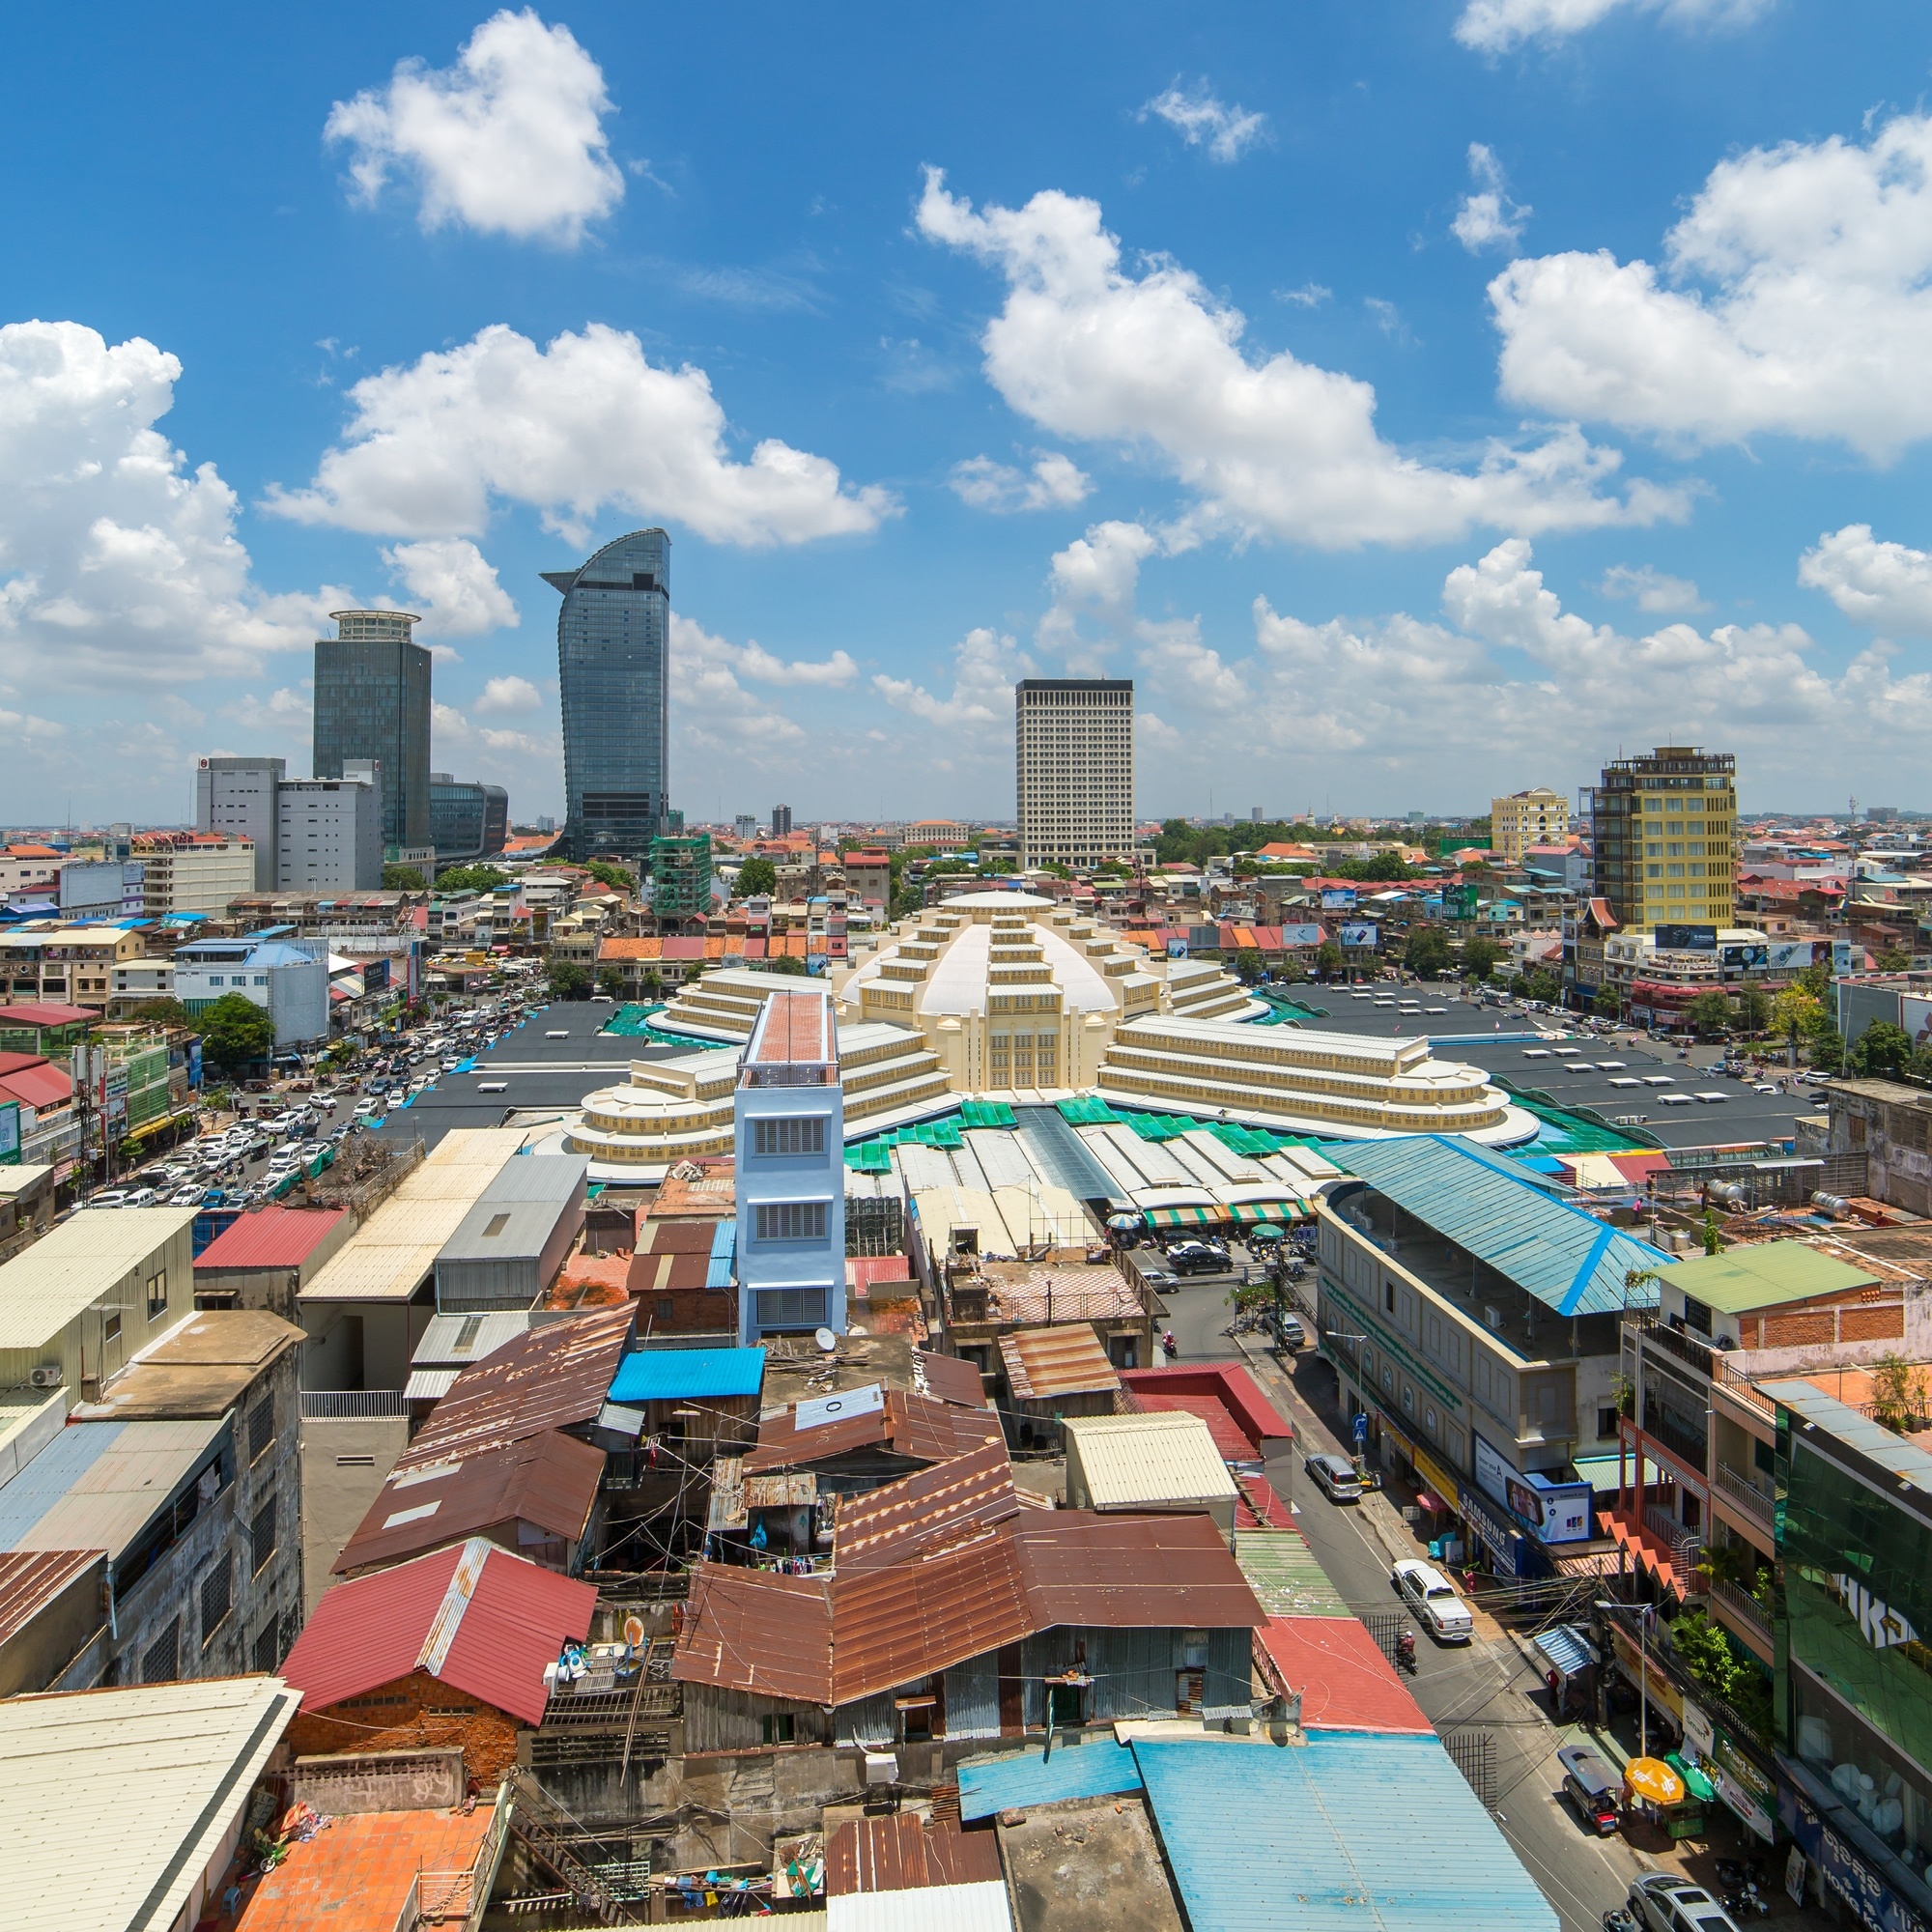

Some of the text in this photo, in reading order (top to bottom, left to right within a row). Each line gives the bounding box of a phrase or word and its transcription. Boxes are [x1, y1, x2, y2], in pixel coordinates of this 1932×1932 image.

[1463, 1493, 1506, 1546] SAMSUNG
[1721, 1740, 1747, 1771] Smart
[1747, 1767, 1769, 1794] Spot
[1822, 1864, 1861, 1915] HONG
